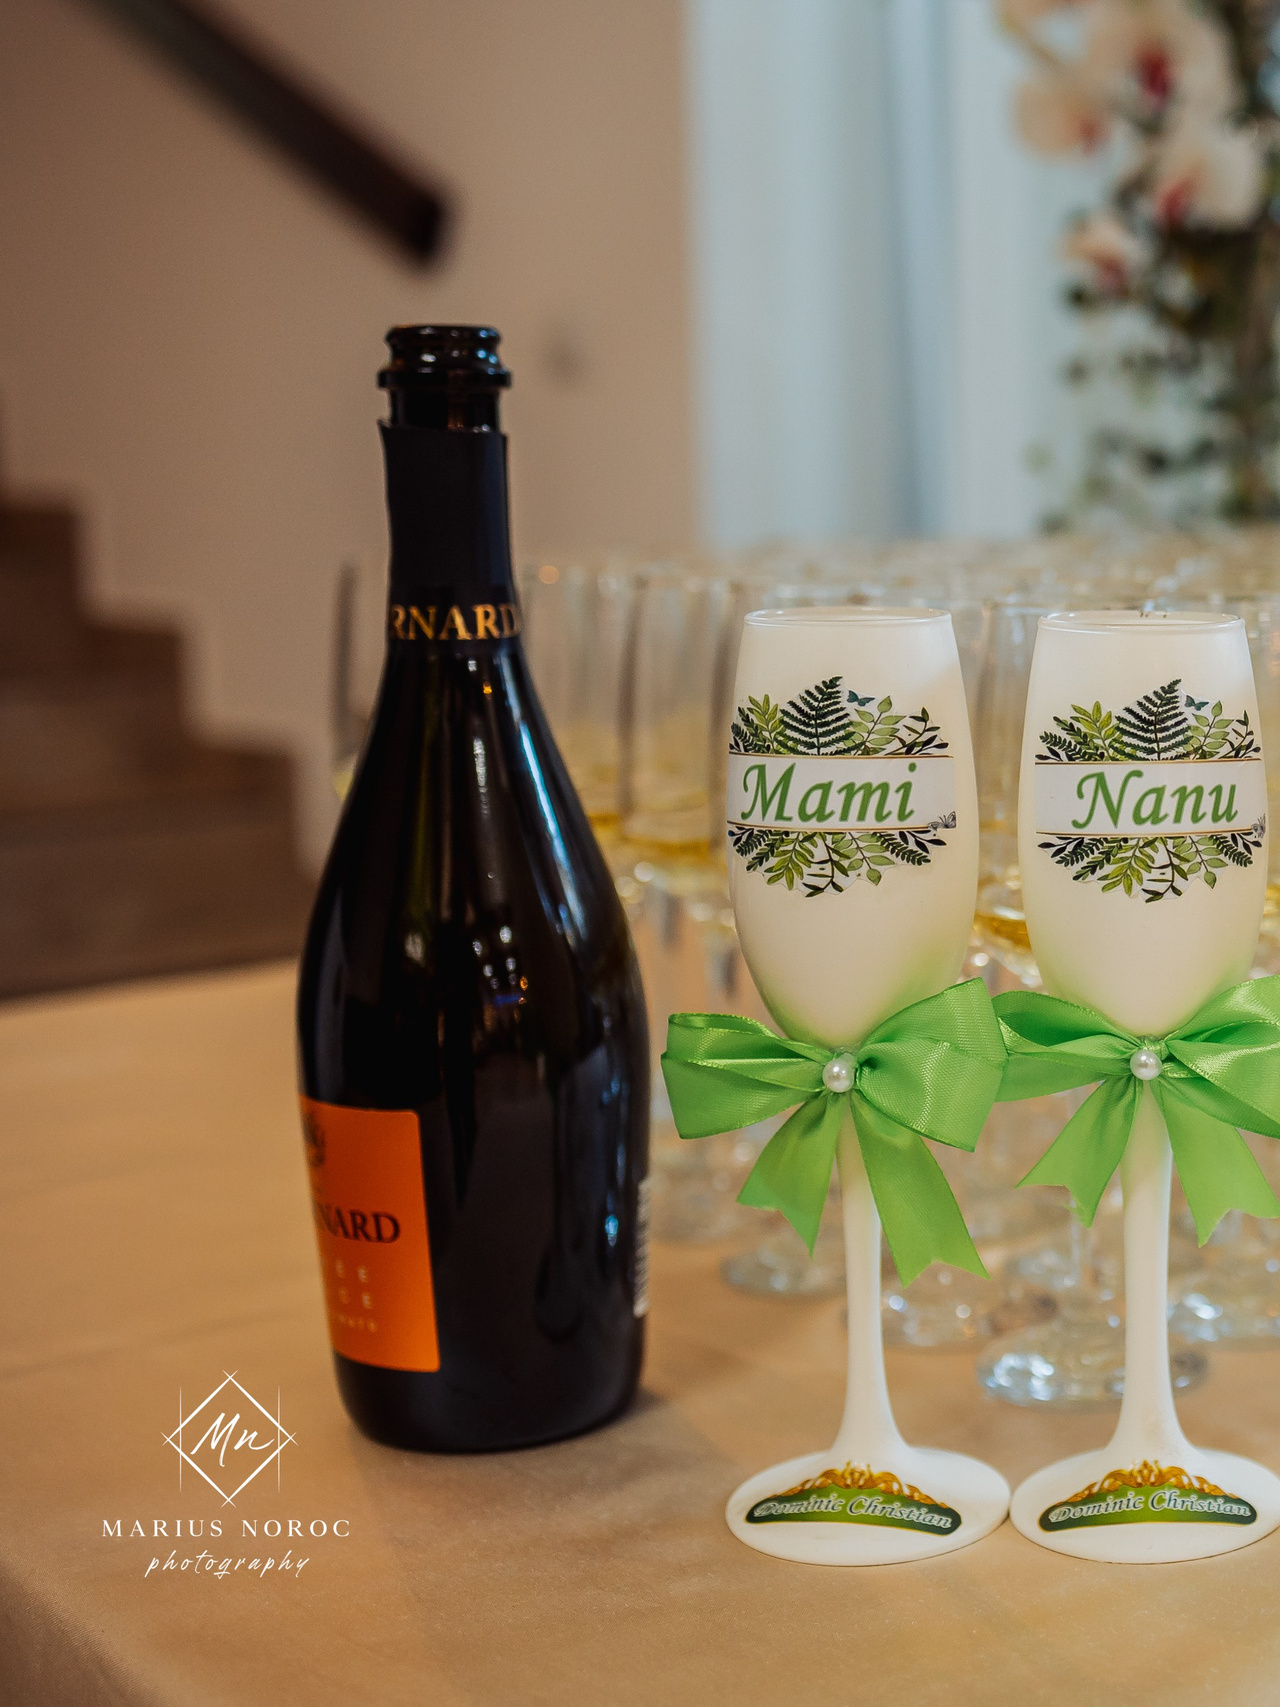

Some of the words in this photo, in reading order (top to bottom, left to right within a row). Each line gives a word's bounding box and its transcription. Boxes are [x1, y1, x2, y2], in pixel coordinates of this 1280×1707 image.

[740, 761, 917, 823] Mami
[1071, 769, 1238, 829] Nanu
[753, 1493, 843, 1517] Dominic
[847, 1494, 952, 1529] Christian
[1048, 1491, 1143, 1523] Dominic
[1149, 1488, 1252, 1517] Christian
